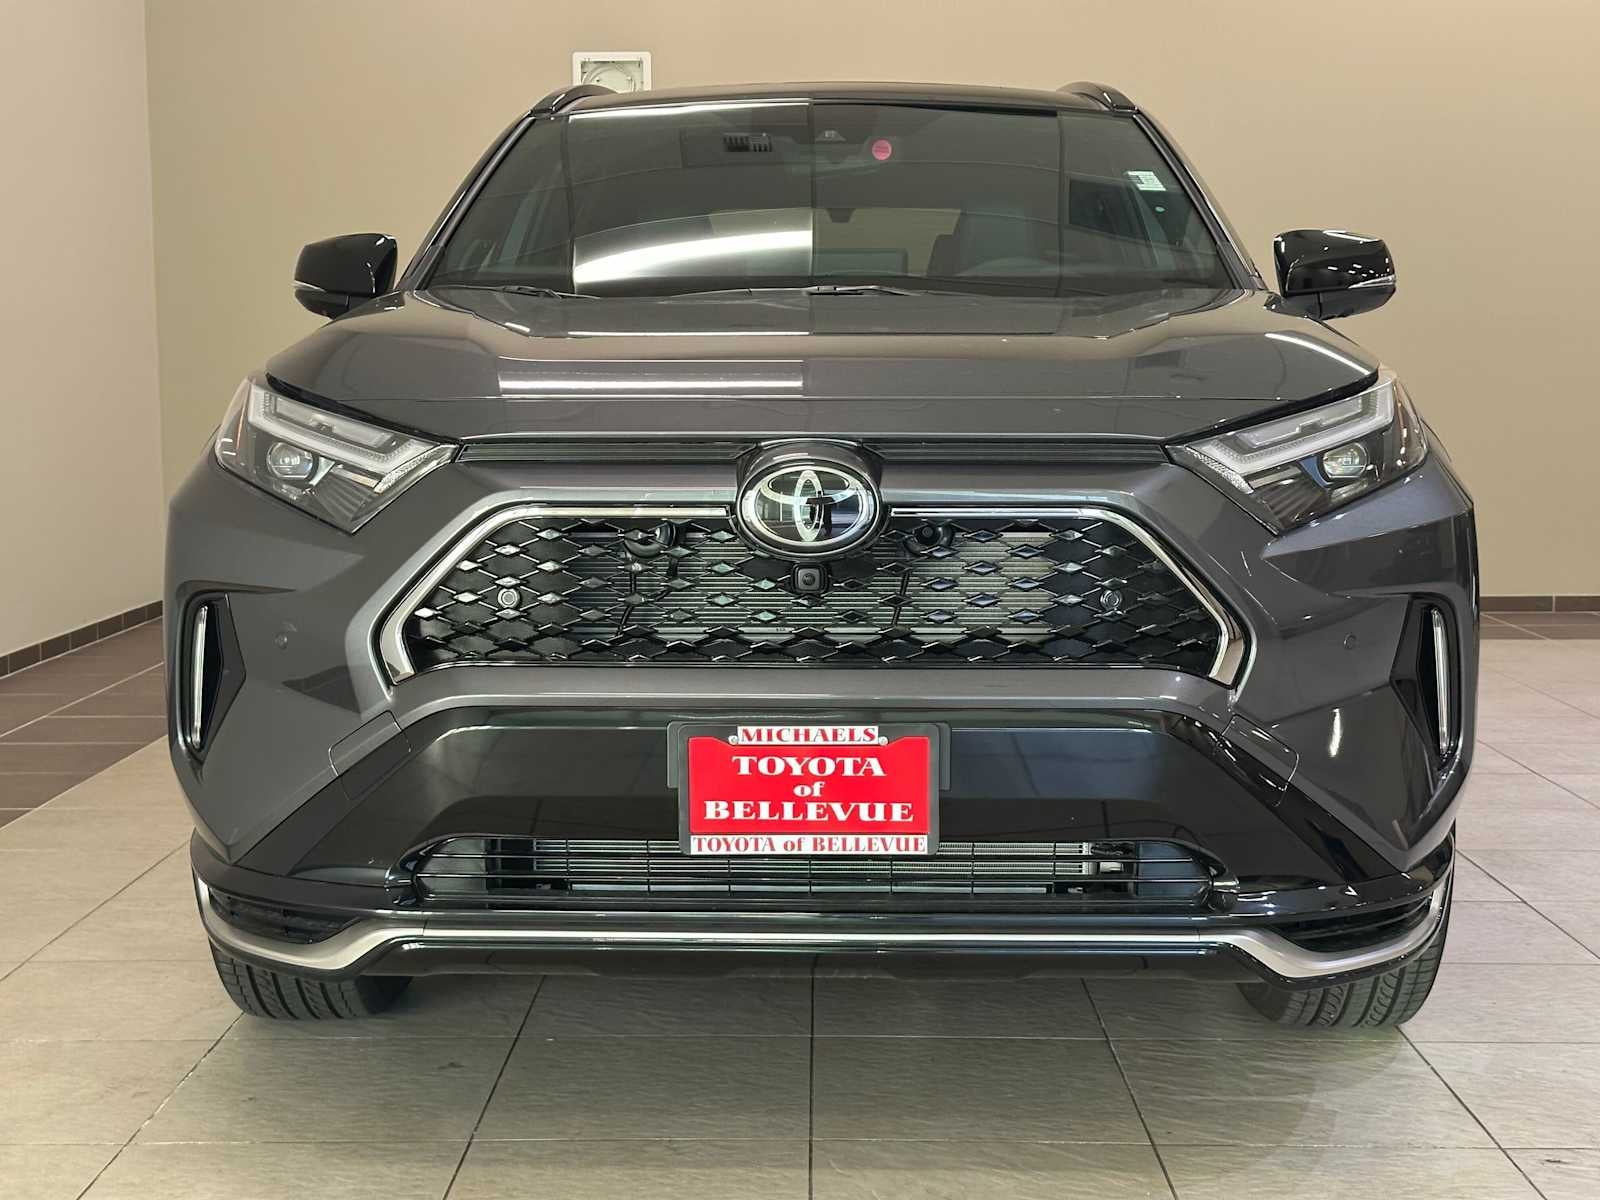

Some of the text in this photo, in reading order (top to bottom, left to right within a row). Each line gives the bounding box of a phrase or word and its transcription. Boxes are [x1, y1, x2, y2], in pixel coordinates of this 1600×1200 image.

[741, 728, 876, 743] MICHAELS
[731, 756, 886, 777] TOYOTA
[793, 781, 825, 797] of
[704, 800, 914, 822] BELLEVUE
[693, 836, 926, 853] TOYOTA of BELLEVUE
